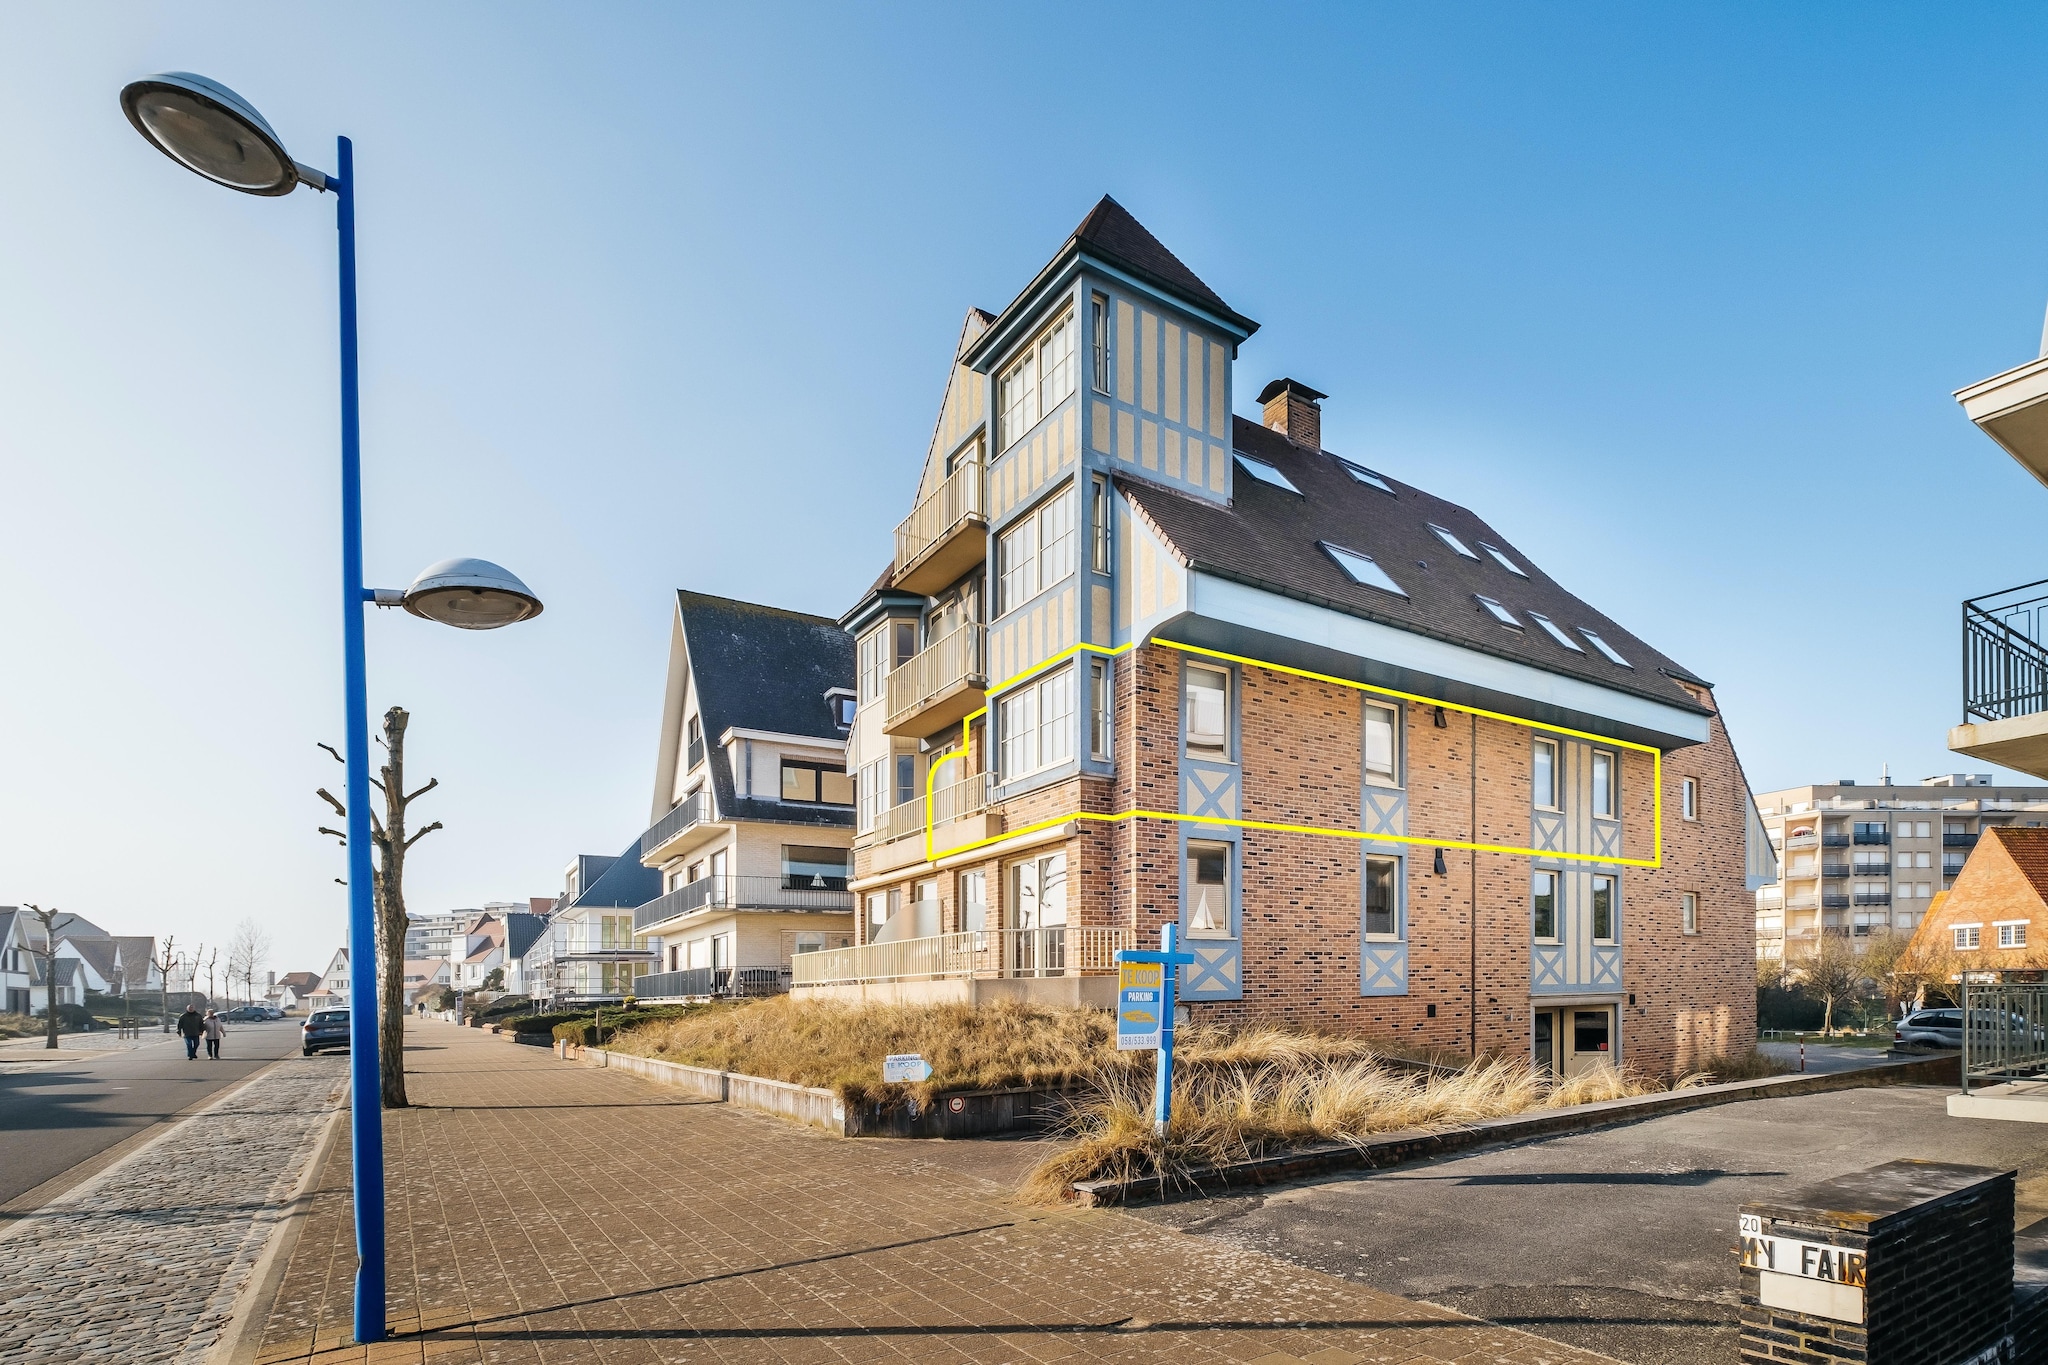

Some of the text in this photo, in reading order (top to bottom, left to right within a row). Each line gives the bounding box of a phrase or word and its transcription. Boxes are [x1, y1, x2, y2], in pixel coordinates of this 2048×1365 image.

[1122, 969, 1160, 985] TE KOOP
[1128, 991, 1153, 1001] PARKING
[1742, 1217, 1758, 1233] 20
[1740, 1235, 1867, 1284] MY FAIR
